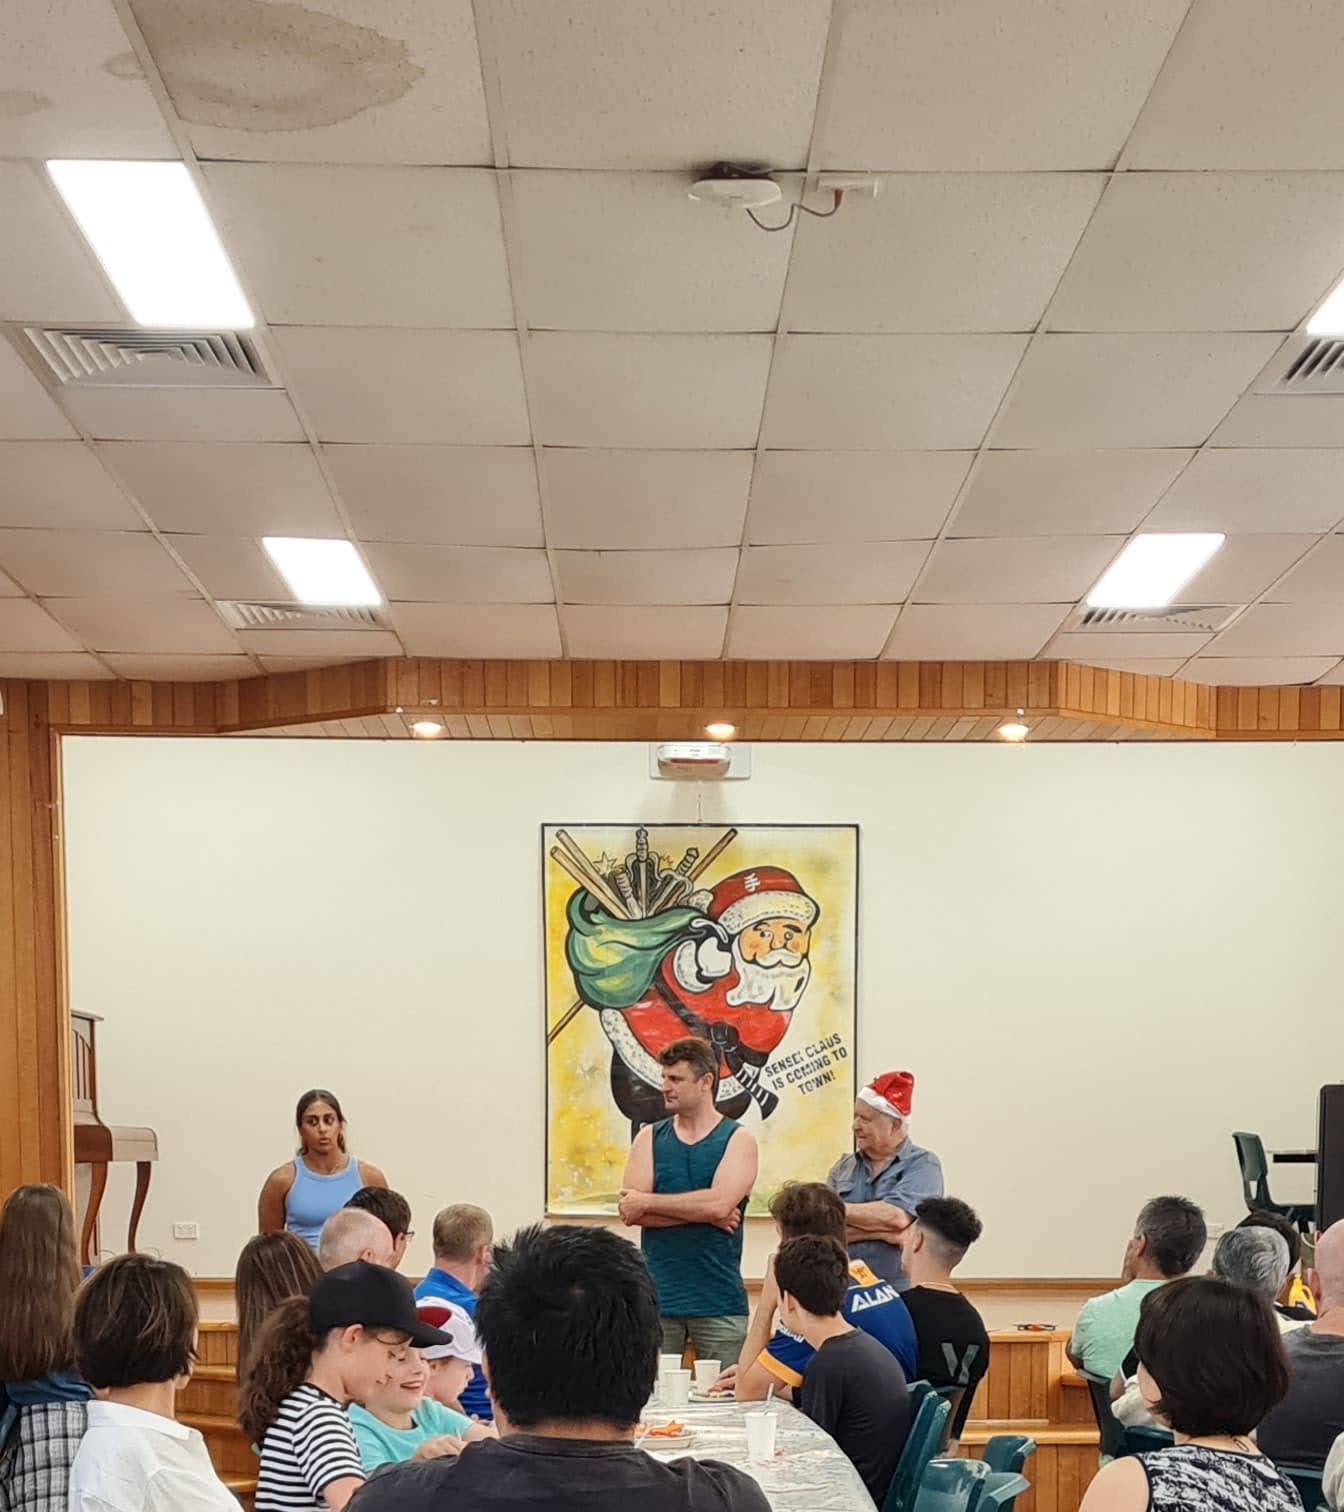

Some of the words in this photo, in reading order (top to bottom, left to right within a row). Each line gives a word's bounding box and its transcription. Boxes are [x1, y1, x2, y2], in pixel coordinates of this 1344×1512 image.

[805, 1033, 842, 1058] CLAUS
[771, 1077, 784, 1090] IS
[786, 1055, 831, 1083] COMING
[831, 1046, 848, 1061] TO
[797, 1069, 837, 1095] TOWN!
